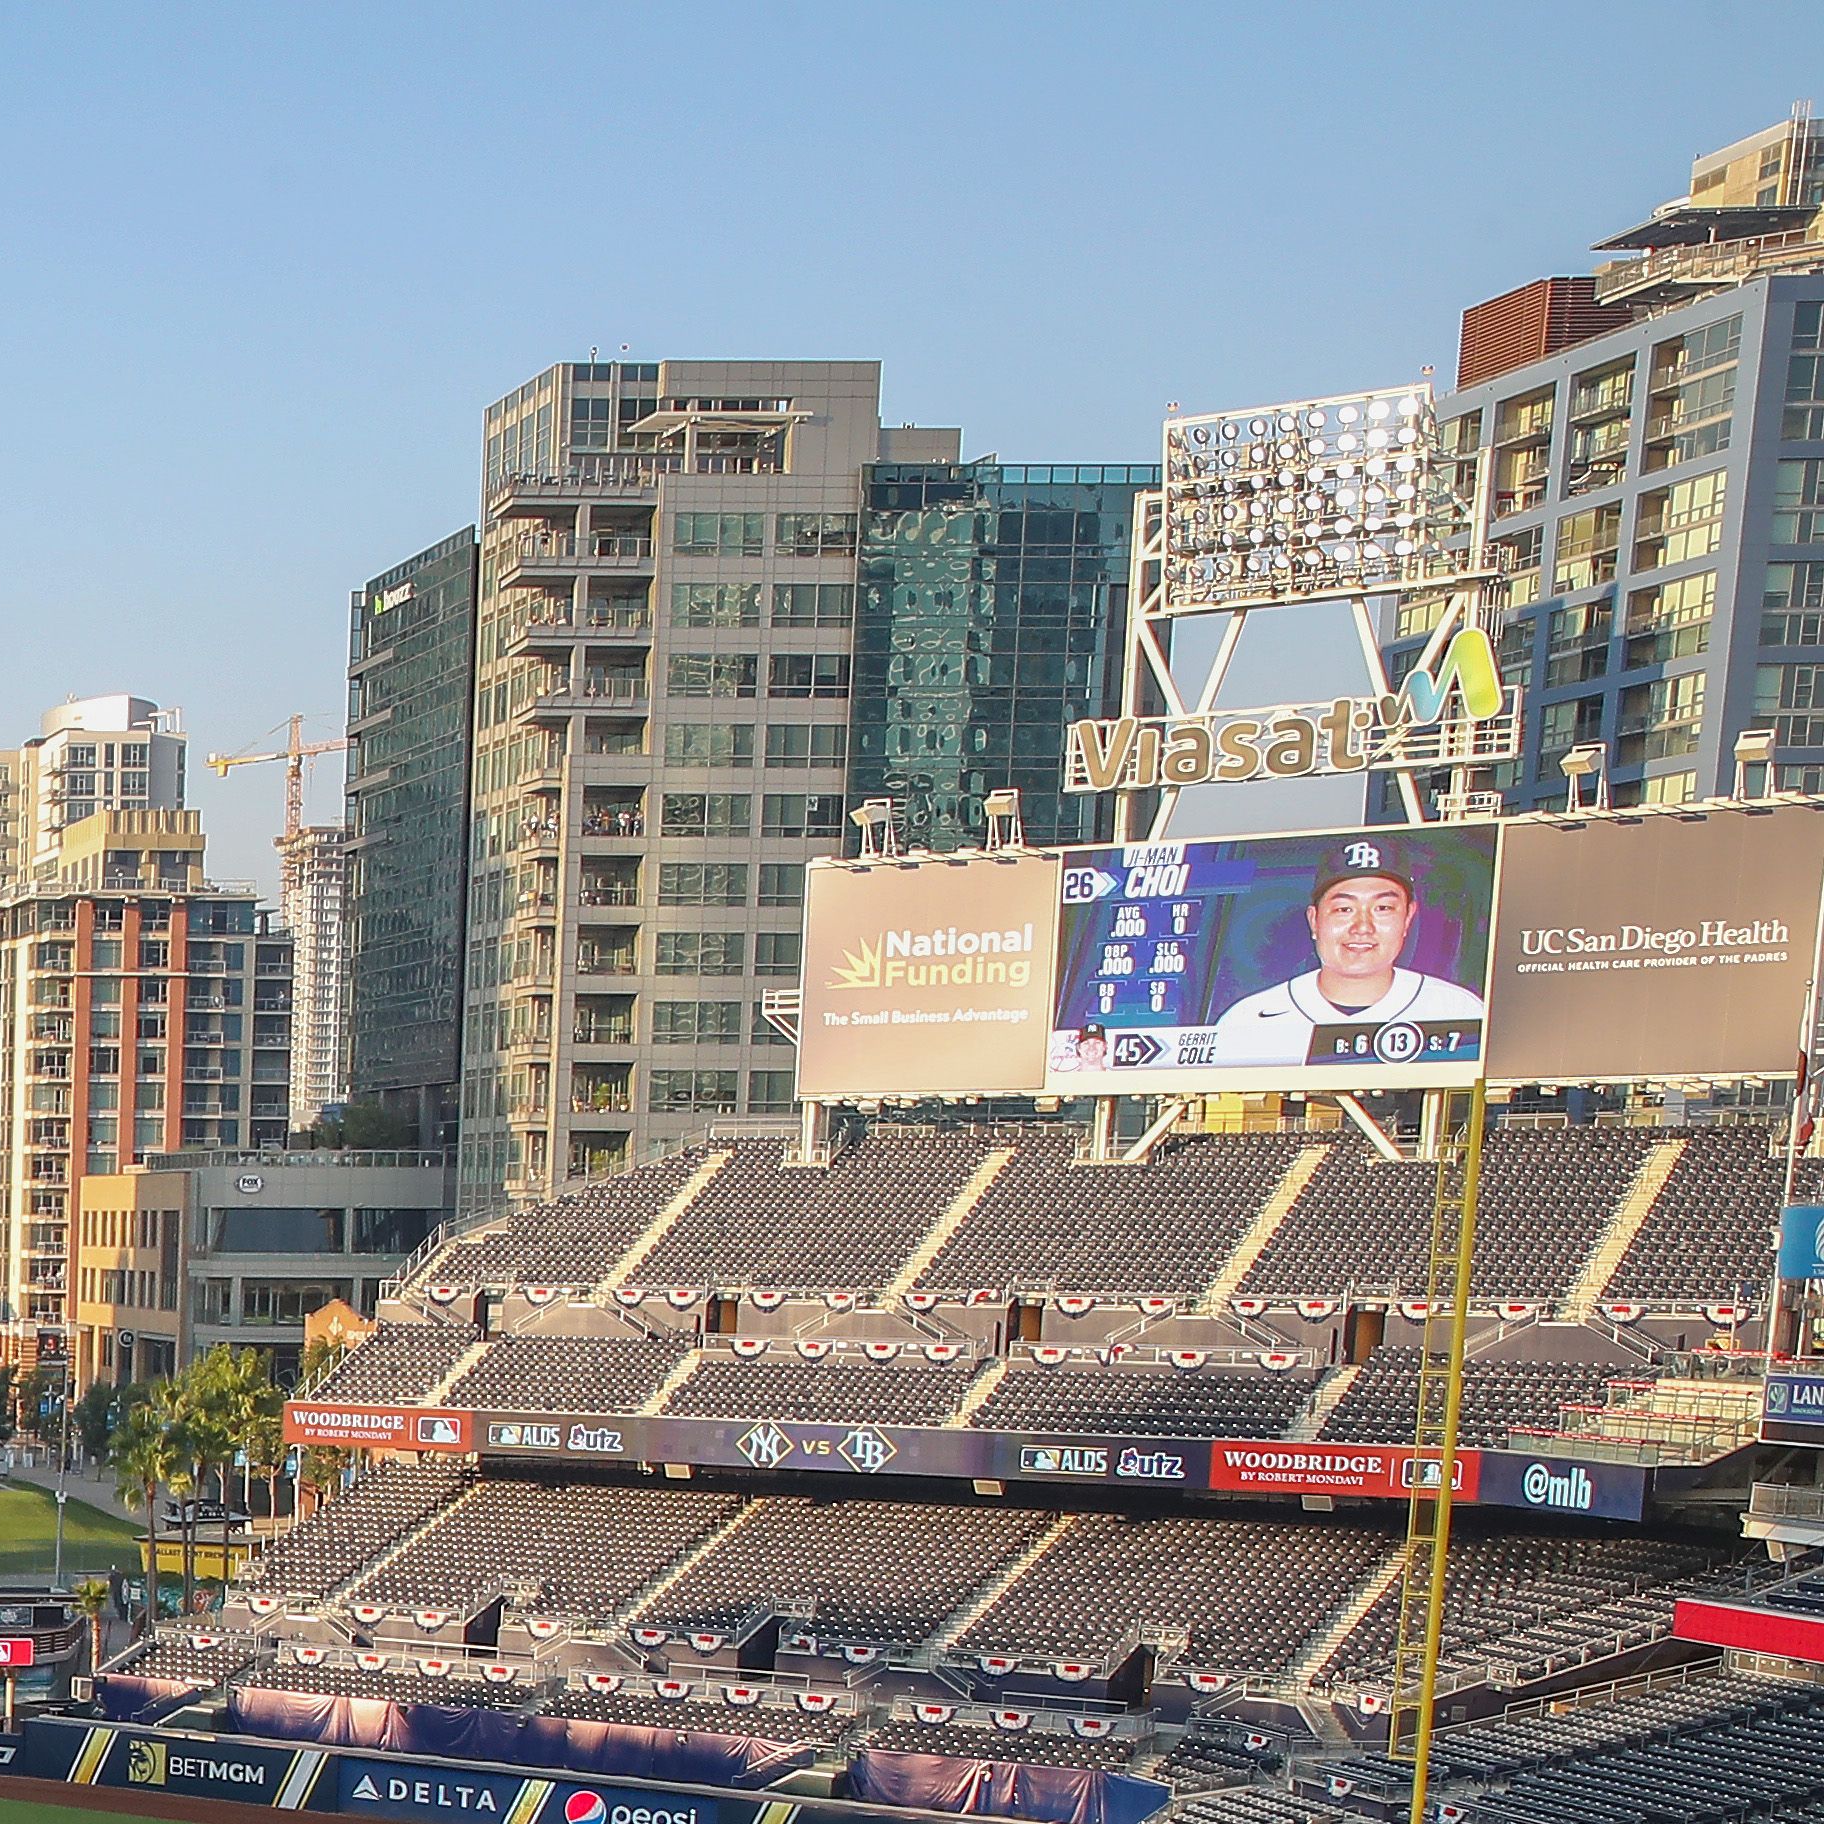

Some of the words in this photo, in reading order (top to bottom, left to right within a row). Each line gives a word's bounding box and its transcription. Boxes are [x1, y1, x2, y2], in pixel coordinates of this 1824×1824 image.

[1074, 698, 1366, 791] Viasat
[1065, 872, 1093, 899] 26
[1123, 864, 1190, 899] CHOI
[885, 924, 1034, 958] National
[1520, 929, 1564, 955] UC
[1566, 927, 1617, 954] San
[1618, 925, 1696, 954] Diego
[1697, 918, 1789, 948] Health
[884, 956, 1031, 989] Funding
[1517, 962, 1564, 974] OFFICIAL
[1567, 960, 1609, 972] HEALTH
[1612, 959, 1640, 970] CARE
[1643, 956, 1697, 968] PROVIDER
[1700, 954, 1716, 965] OF
[1718, 953, 1740, 964] THE
[1743, 951, 1788, 963] PADRES
[823, 1012, 849, 1027] The
[851, 1010, 889, 1026] Small
[890, 1009, 950, 1025] Business
[952, 1006, 1029, 1024] Advantage
[1177, 1046, 1215, 1065] COLE
[292, 1409, 404, 1432] WOODBRIDGE
[521, 1425, 561, 1448] ALDS
[1061, 1449, 1108, 1473] ALDS
[1224, 1450, 1383, 1475] WOODBRIDGE
[1241, 1471, 1256, 1483] BY
[1258, 1471, 1303, 1485] ROBERT
[1305, 1473, 1364, 1488] MONDAVI
[1523, 1462, 1593, 1511] @mlb
[169, 1755, 265, 1786] BETMGM
[389, 1777, 497, 1813] DELTA
